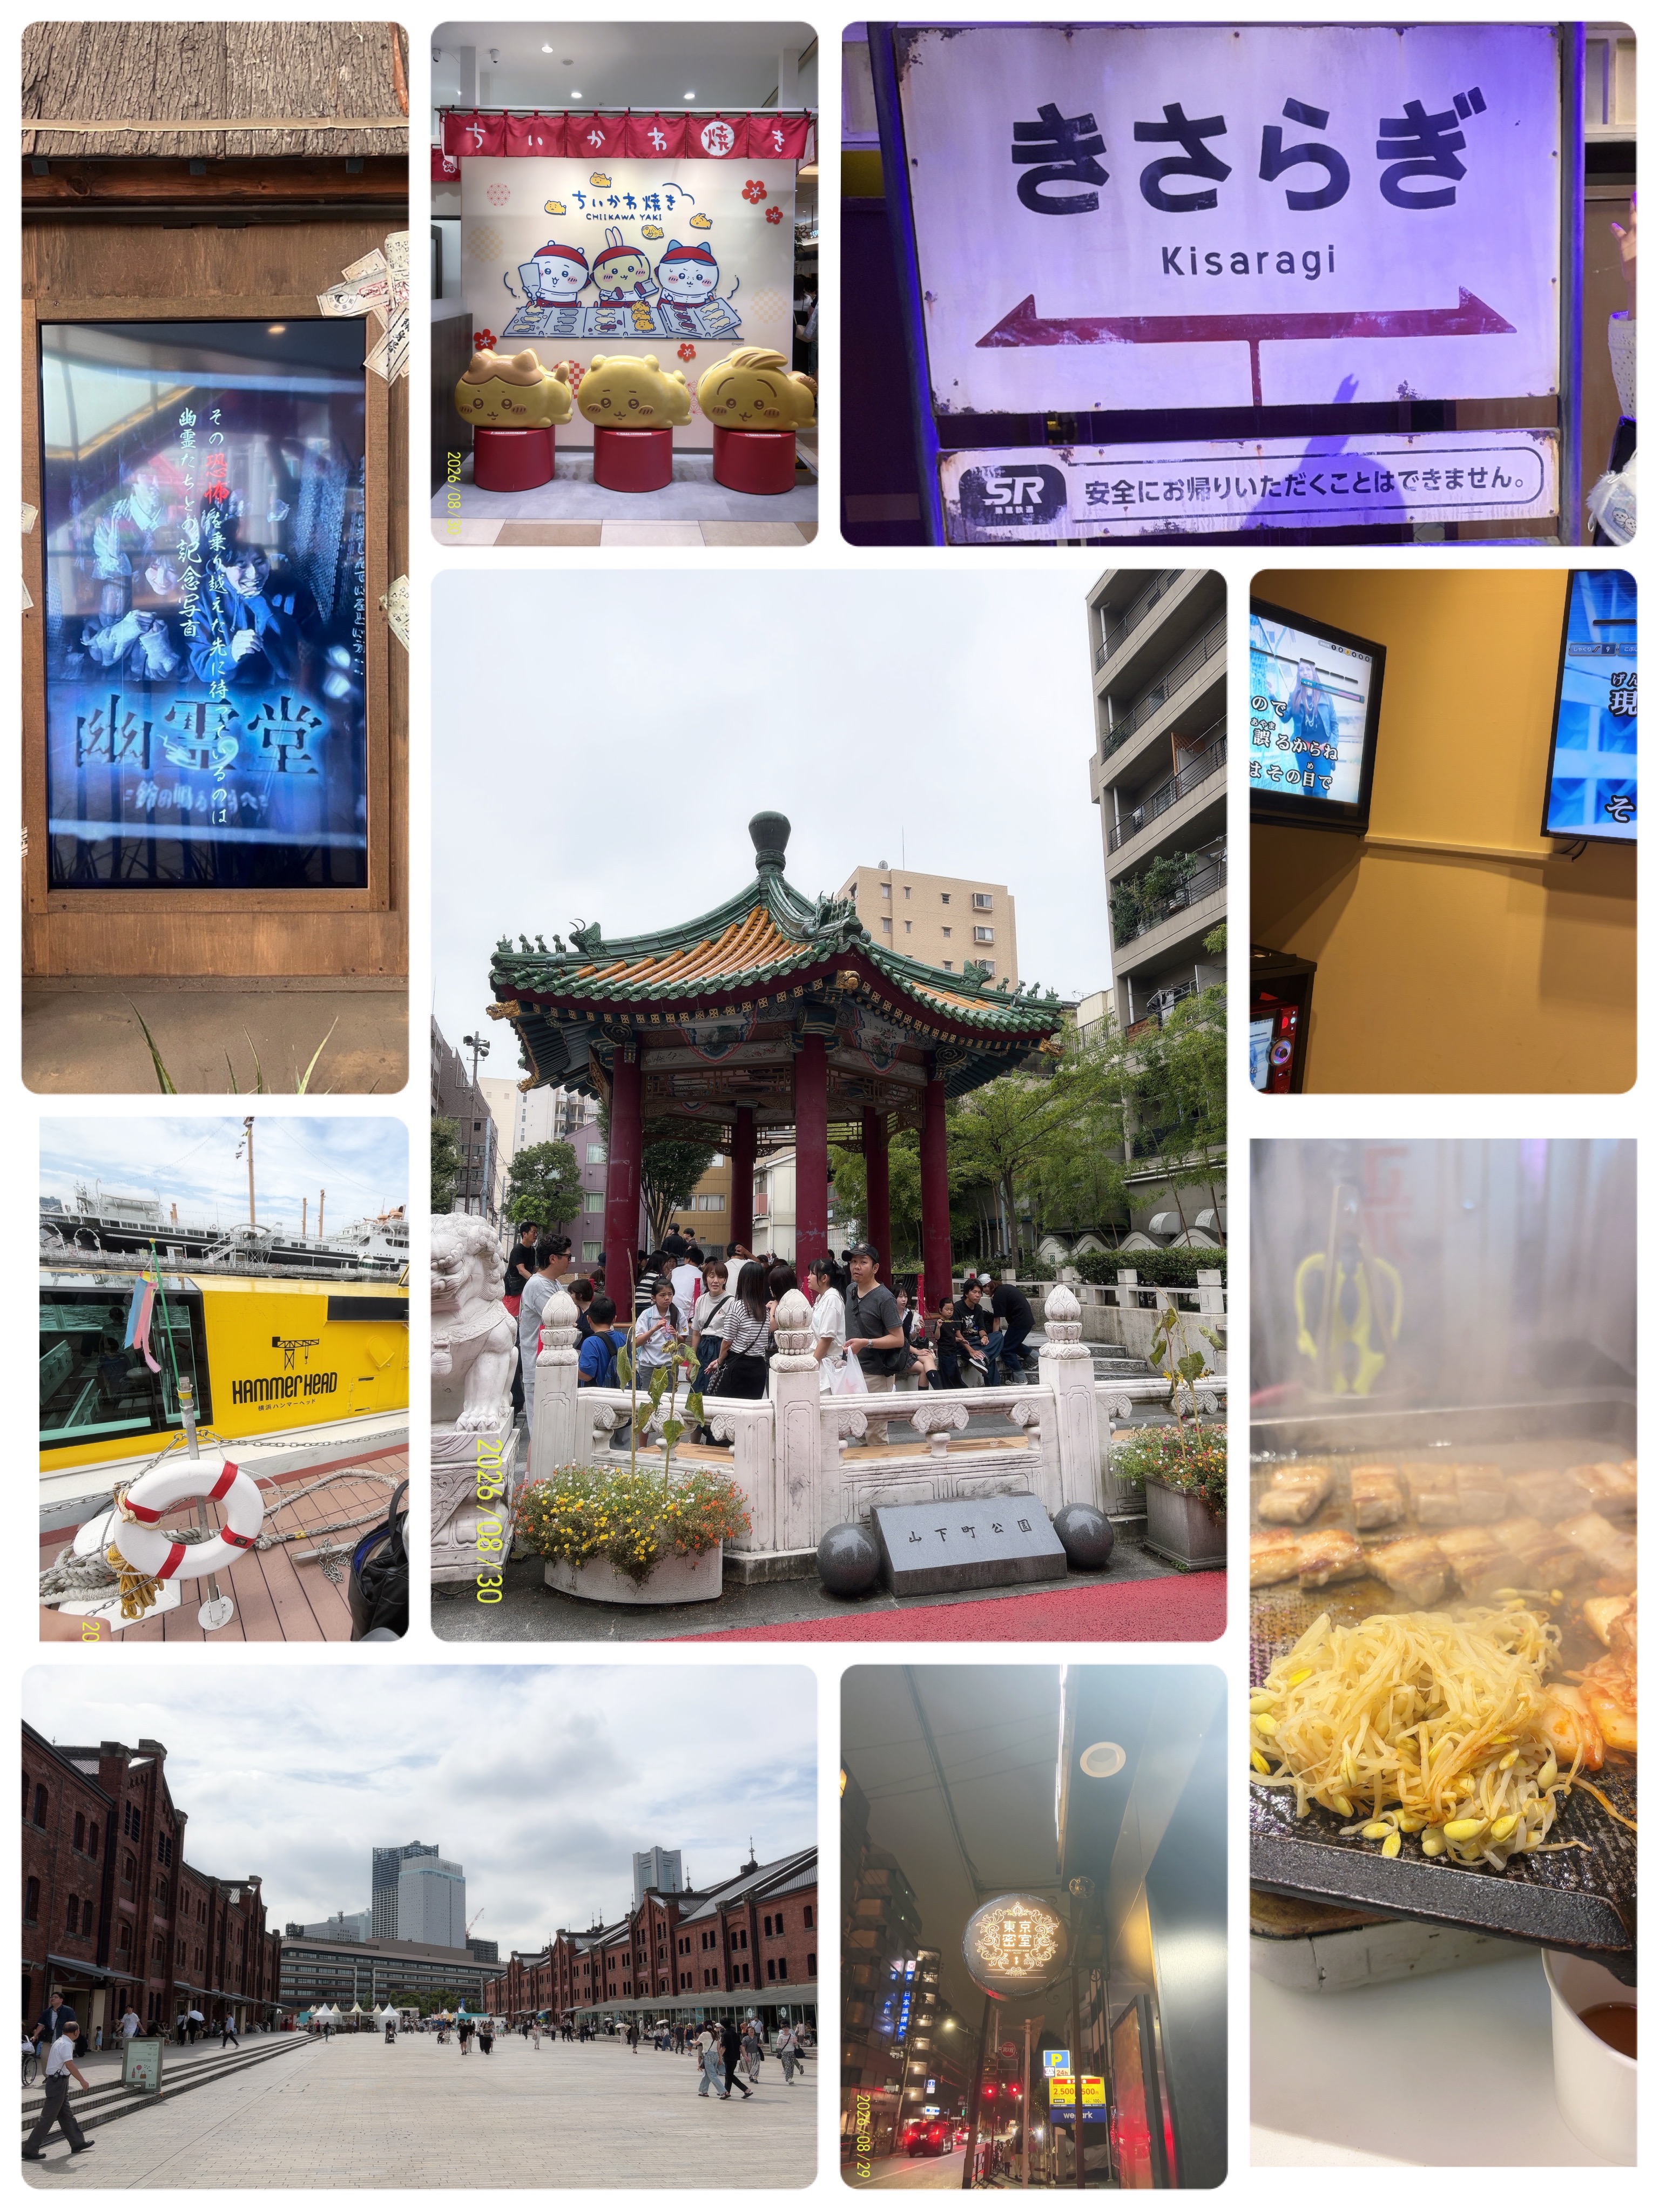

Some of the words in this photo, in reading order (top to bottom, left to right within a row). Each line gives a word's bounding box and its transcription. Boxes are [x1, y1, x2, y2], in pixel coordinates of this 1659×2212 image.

[465, 122, 785, 153] ちいかわ焼き
[1011, 86, 1486, 215] きさらぎ
[572, 190, 676, 211] ちいかわ焼き
[1162, 245, 1336, 280] Kisaragi
[982, 476, 1044, 505] SR
[1085, 466, 1525, 505] 安全にお帰りいただくことはできません。
[1252, 696, 1287, 717] ので
[1610, 690, 1637, 716] 現
[1251, 718, 1276, 730] あやま
[1252, 729, 1338, 760] 誤るからね
[1606, 796, 1635, 822] そ
[258, 1398, 316, 1411] 横浜ハンマーヘッド
[909, 1519, 1032, 1542] 山下町公園
[1003, 1920, 1032, 1933] 東京
[1002, 1934, 1032, 1947] 密室
[1051, 2053, 1062, 2066] P
[1063, 2112, 1093, 2120] weark
